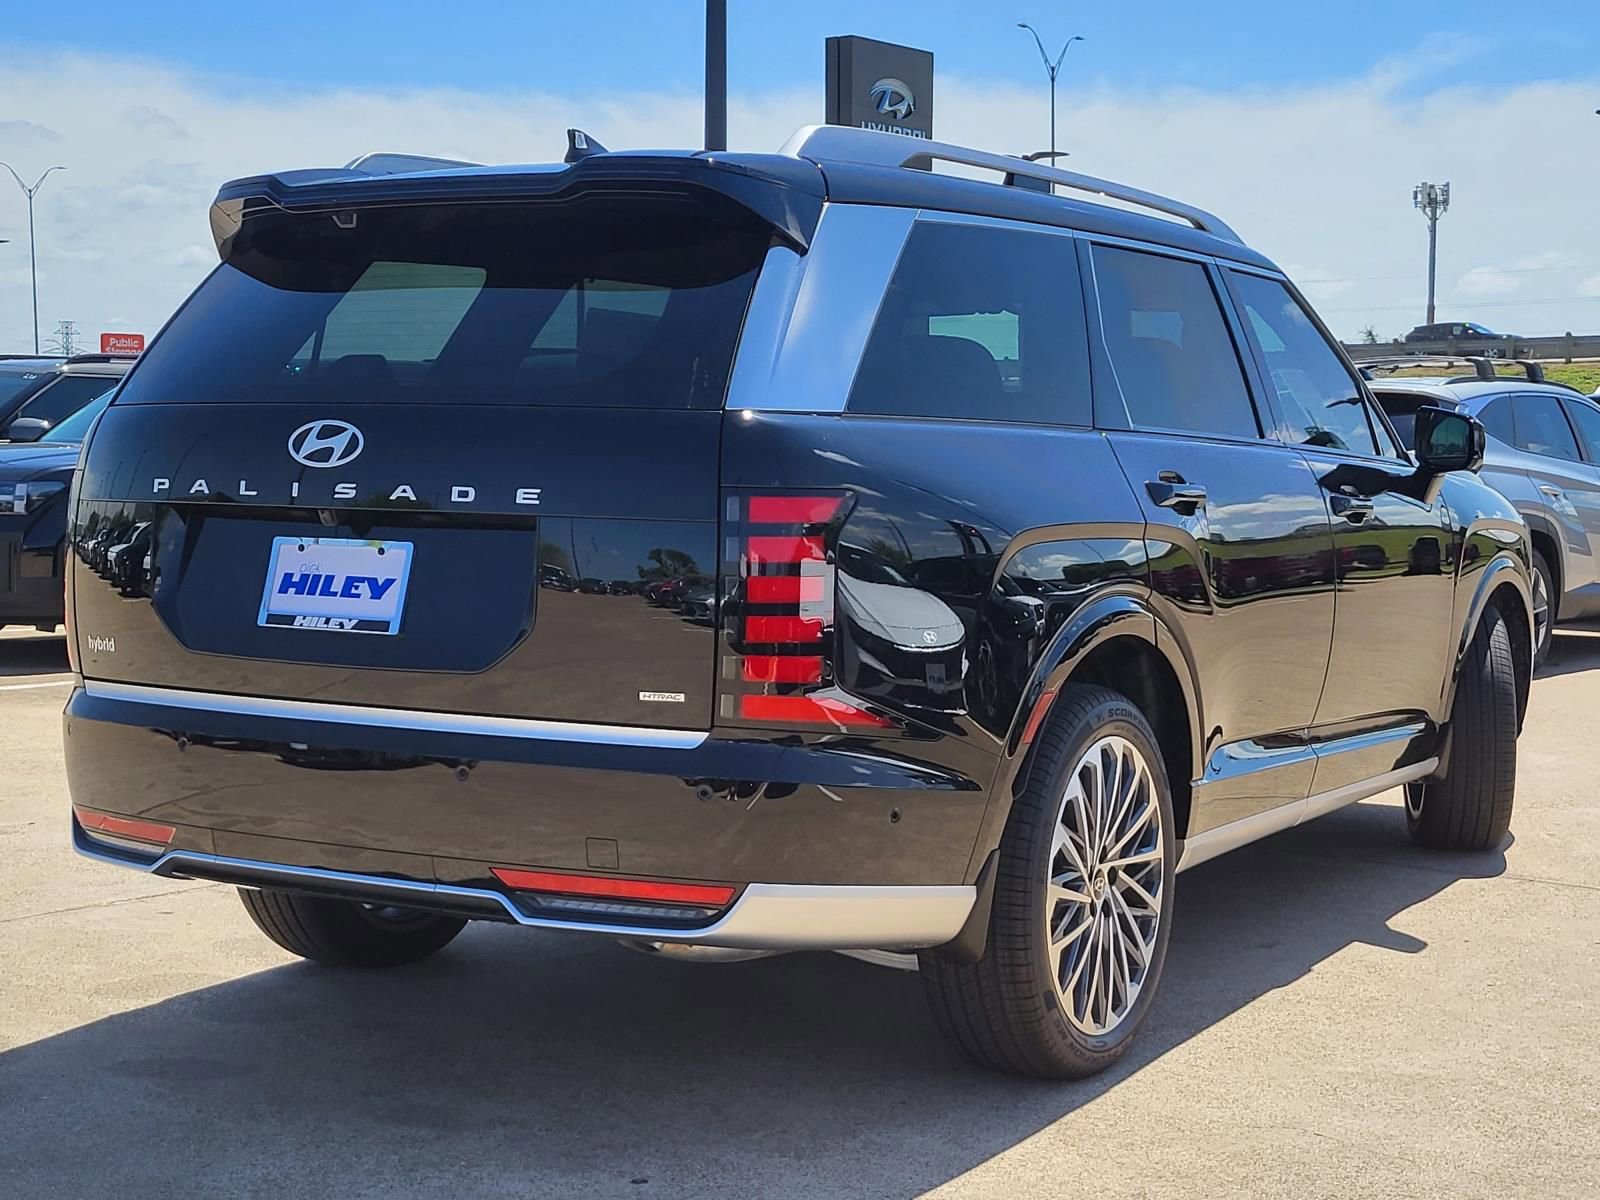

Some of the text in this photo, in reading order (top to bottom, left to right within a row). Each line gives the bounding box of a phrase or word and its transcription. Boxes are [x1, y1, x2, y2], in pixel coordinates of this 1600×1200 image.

[110, 337, 139, 348] Public
[152, 477, 542, 505] PALISADE
[277, 572, 398, 600] HILEY
[293, 615, 360, 630] HILEY
[88, 634, 115, 653] hybrid
[642, 692, 682, 700] HTRAC
